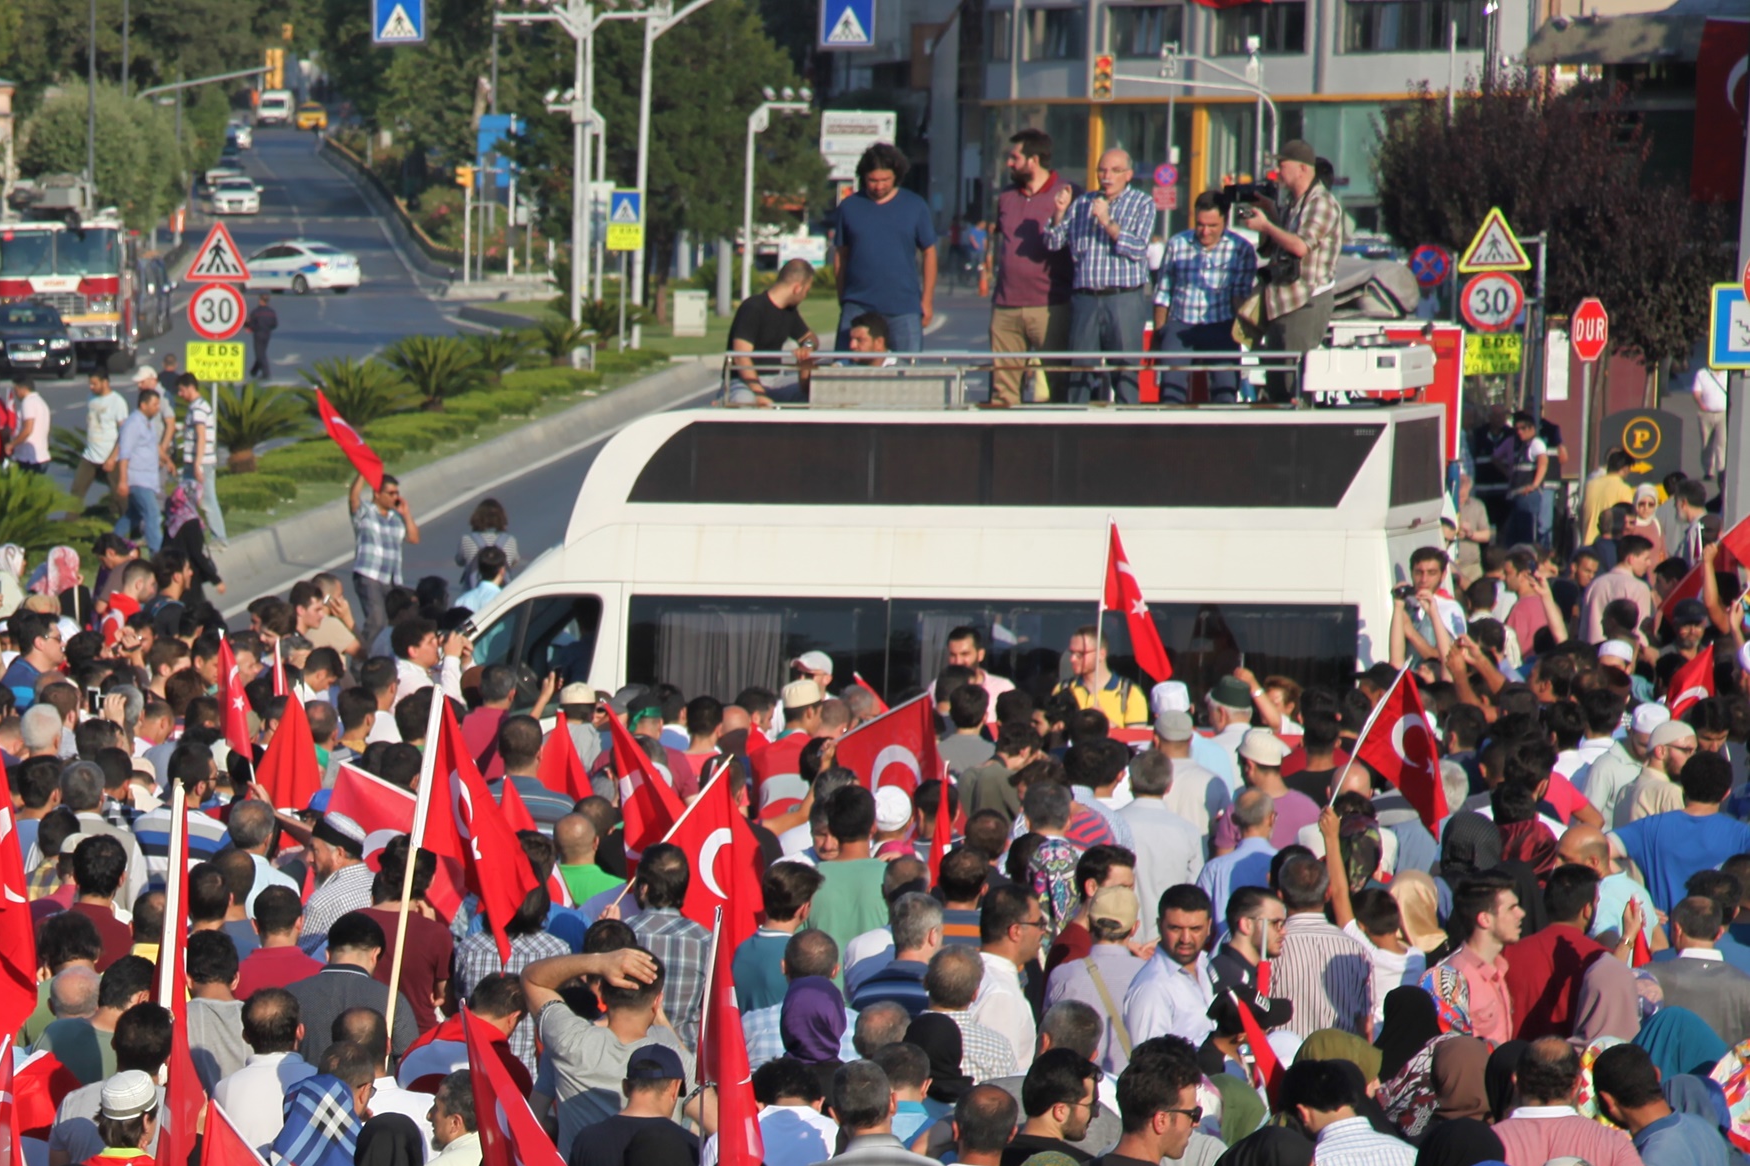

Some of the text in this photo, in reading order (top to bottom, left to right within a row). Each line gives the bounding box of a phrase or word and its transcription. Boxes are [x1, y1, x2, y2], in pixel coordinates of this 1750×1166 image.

[201, 297, 232, 324] 30
[1475, 287, 1510, 315] 30
[1576, 317, 1605, 342] DUR
[207, 345, 240, 356] EDS
[1632, 428, 1651, 449] P
